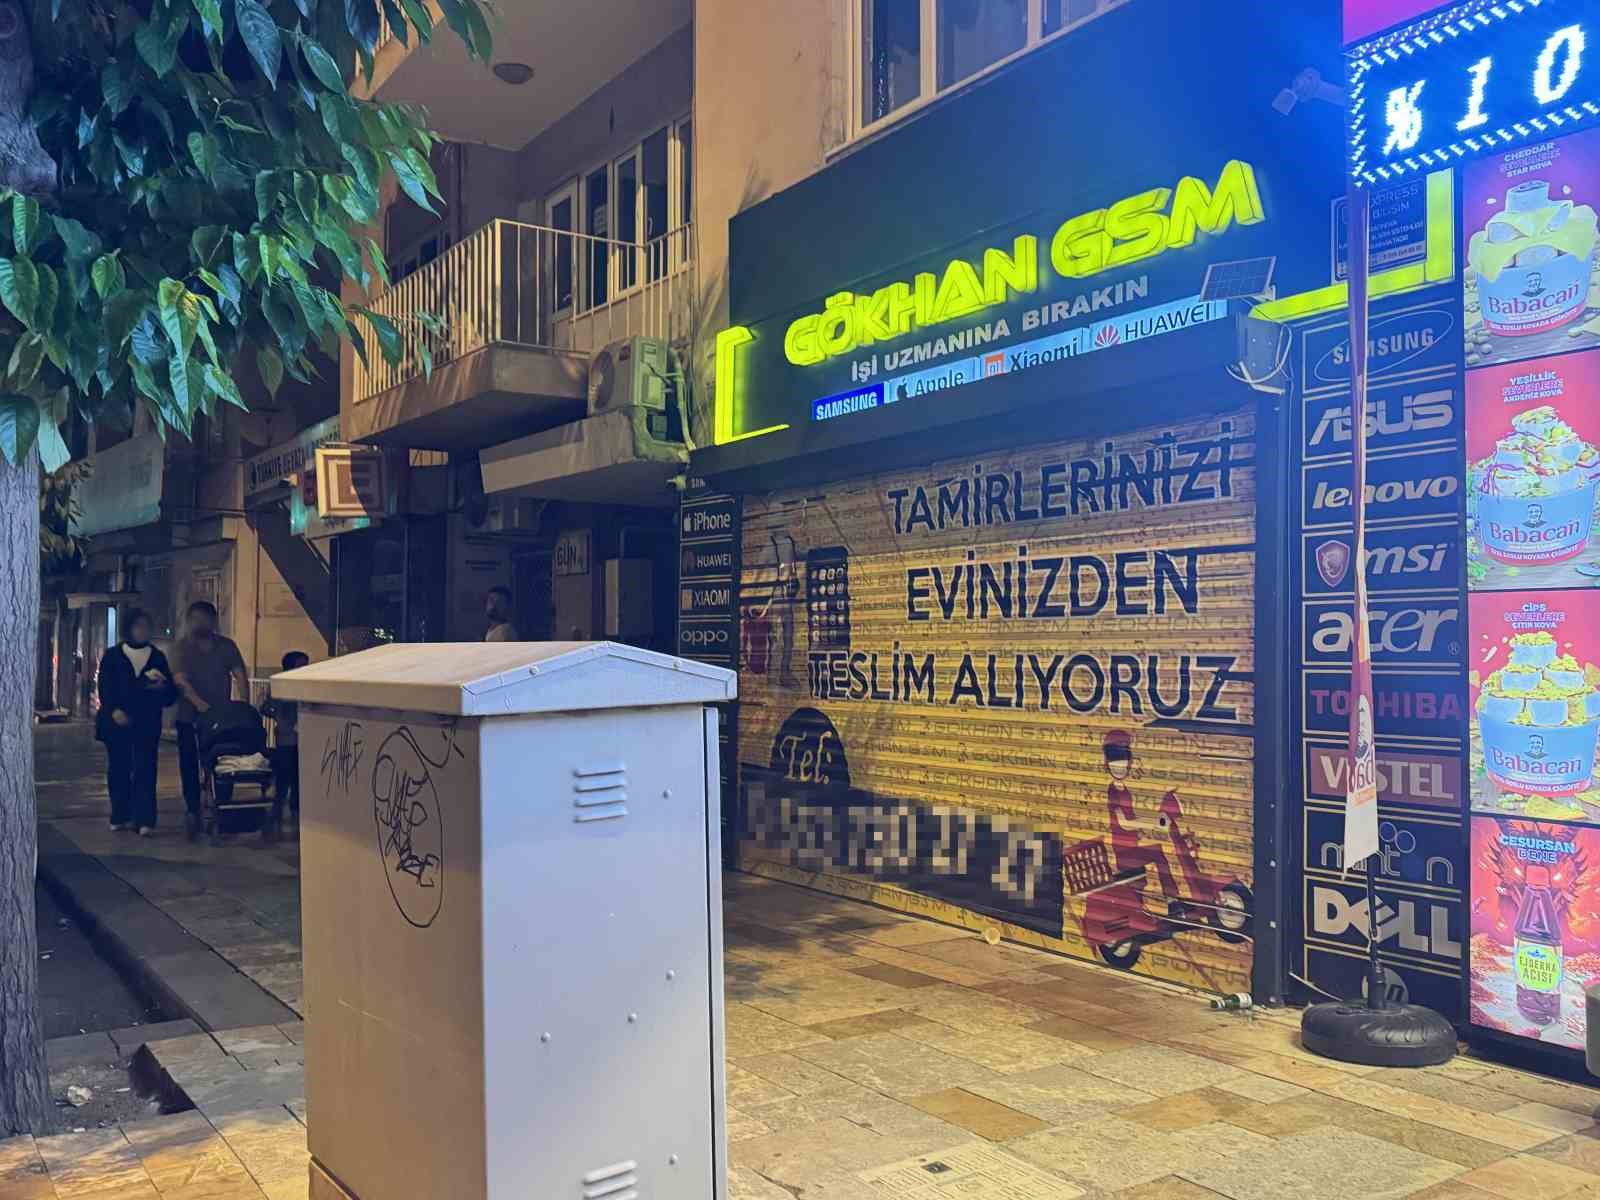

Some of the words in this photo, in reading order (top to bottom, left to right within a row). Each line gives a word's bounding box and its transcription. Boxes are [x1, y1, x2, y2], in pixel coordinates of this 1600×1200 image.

[1504, 142, 1554, 162] CHEDDAR
[784, 234, 1038, 367] GÖKHAN
[1050, 158, 1265, 279] GSM
[1488, 280, 1579, 315] Babacan
[884, 319, 1010, 372] UZMANINA
[1022, 275, 1148, 332] BIRAKIN
[1124, 301, 1211, 341] HUAWEI
[1009, 337, 1079, 372] Xiaomi
[1332, 327, 1434, 365] SSUNG
[815, 391, 878, 420] SAMSUNG
[888, 421, 1234, 535] TAMİRLERİNİZİ
[694, 511, 732, 532] iPhone
[1489, 520, 1580, 543] Babacan
[697, 553, 732, 569] HUAWEI
[1363, 543, 1448, 575] msi
[694, 589, 731, 608] XIAOMI
[905, 545, 1200, 622] EVİNİZDEN
[681, 630, 728, 646] oppo
[950, 654, 1240, 722] ALIYORUZ
[1311, 689, 1462, 721] TOHIBA
[780, 730, 833, 785] Tel:
[1491, 746, 1582, 775] Babacan
[1320, 755, 1455, 800] VSTEL
[1500, 834, 1576, 854] CESURSAN
[1313, 886, 1462, 959] DELL
